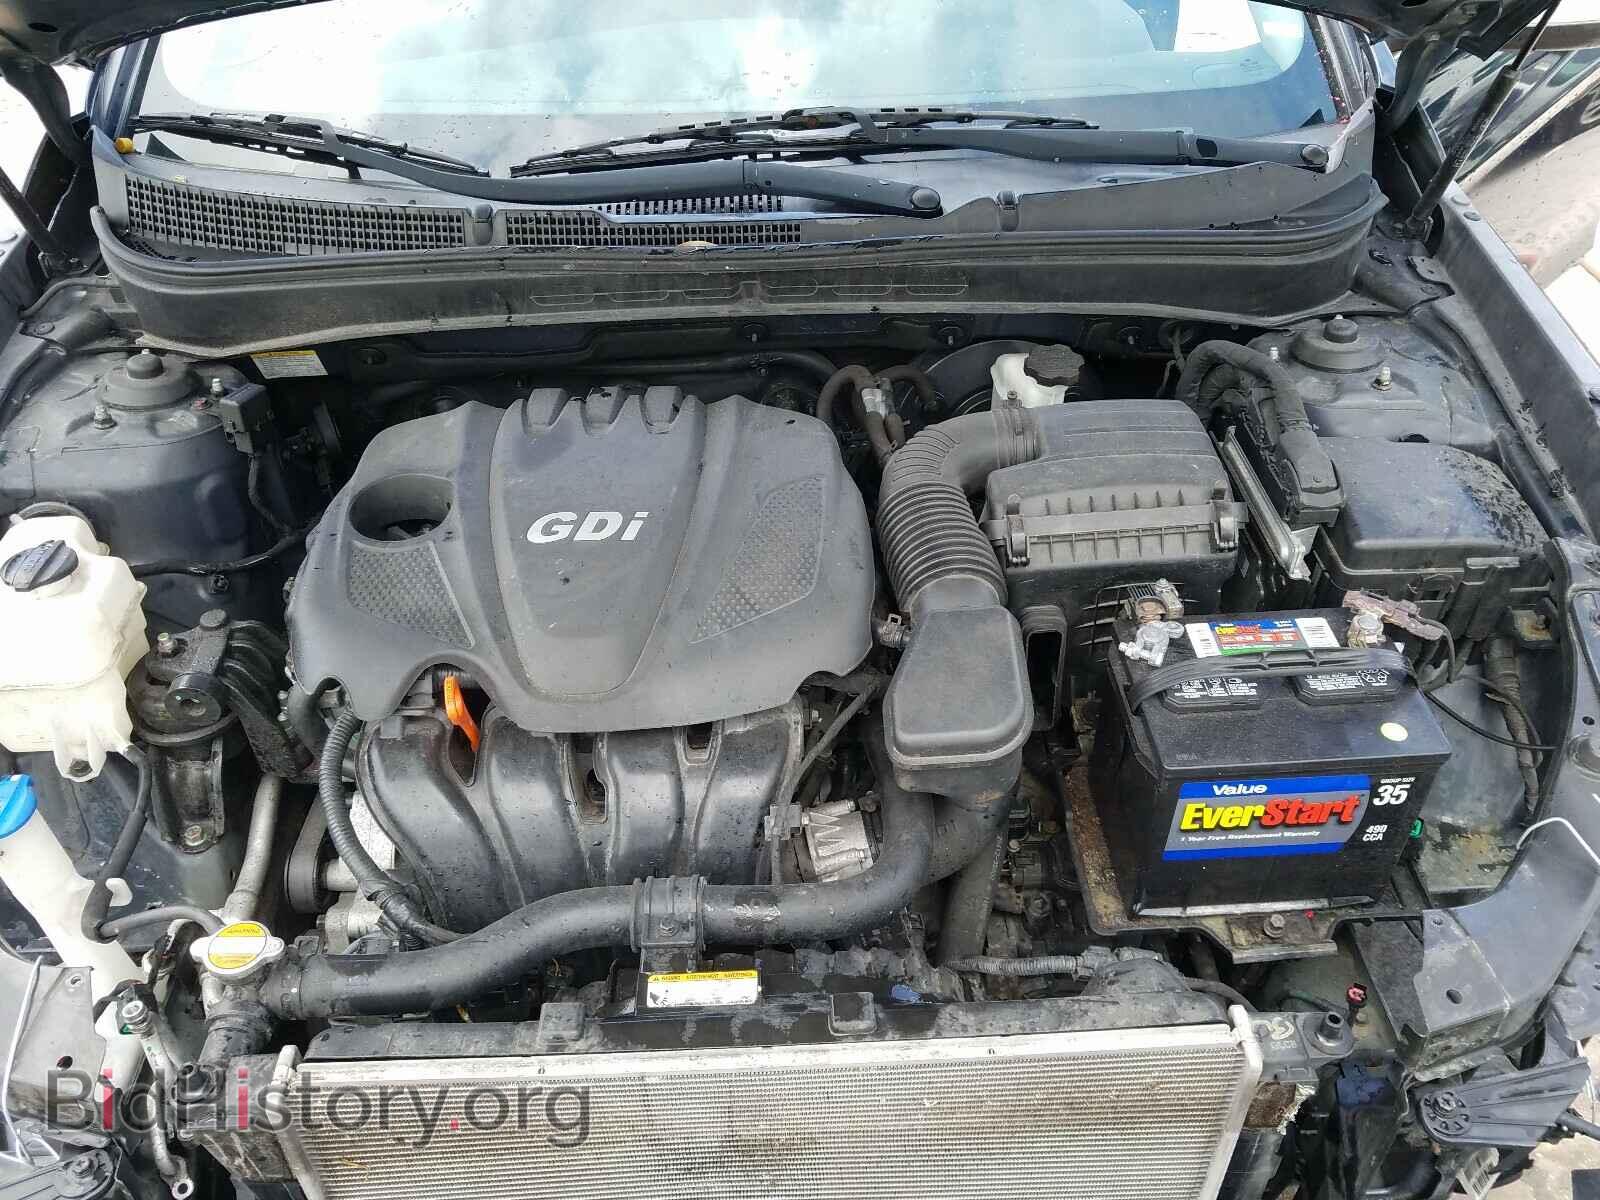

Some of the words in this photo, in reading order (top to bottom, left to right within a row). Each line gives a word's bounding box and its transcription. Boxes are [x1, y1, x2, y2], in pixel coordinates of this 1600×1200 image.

[526, 511, 649, 544] GDi
[1212, 783, 1268, 796] Value
[1372, 784, 1411, 806] 35
[1179, 795, 1362, 832] EverStart
[1362, 833, 1384, 842] CCA
